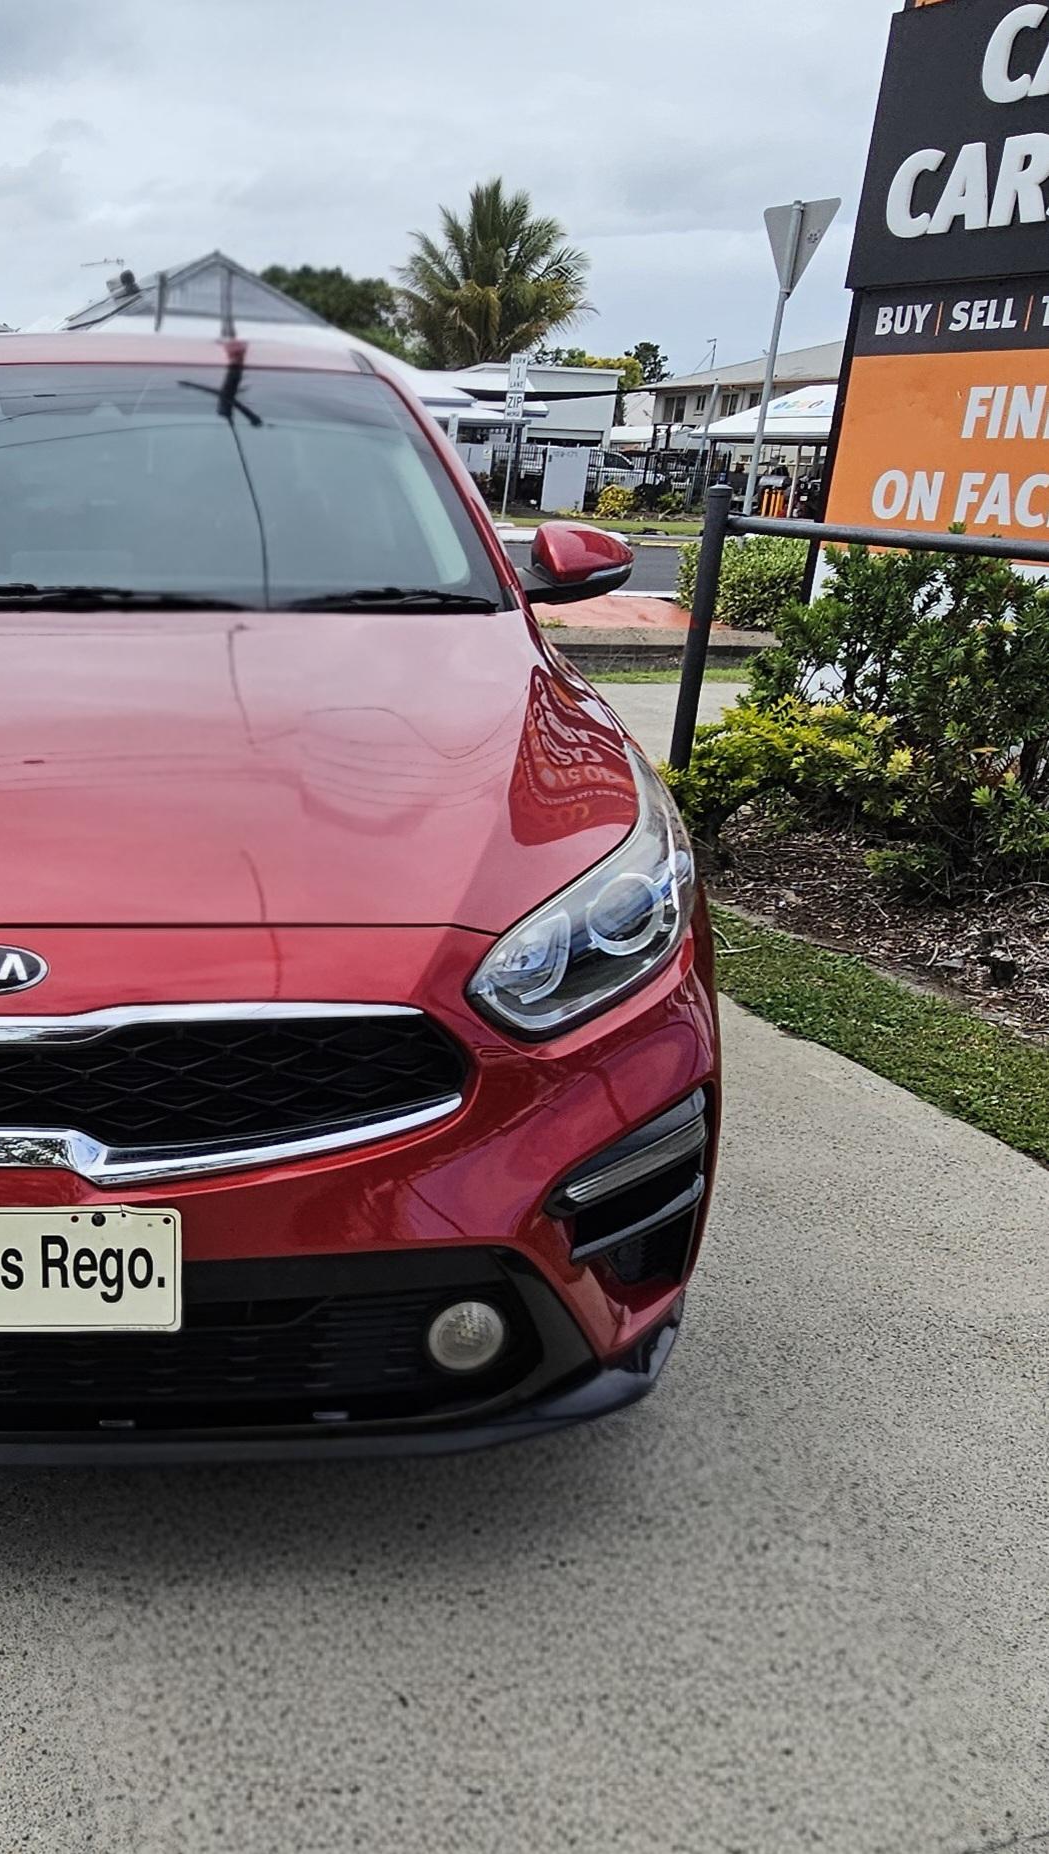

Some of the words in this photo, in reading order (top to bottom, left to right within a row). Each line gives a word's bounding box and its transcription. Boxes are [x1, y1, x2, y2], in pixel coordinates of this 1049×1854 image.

[886, 132, 1049, 239] CAR
[875, 303, 933, 335] BUY
[948, 297, 1017, 332] SELL
[507, 396, 522, 408] ZIP
[961, 385, 1049, 439] FIN
[871, 469, 945, 521] ON
[953, 472, 1049, 528] FAC
[41, 1234, 166, 1304] Rego.
